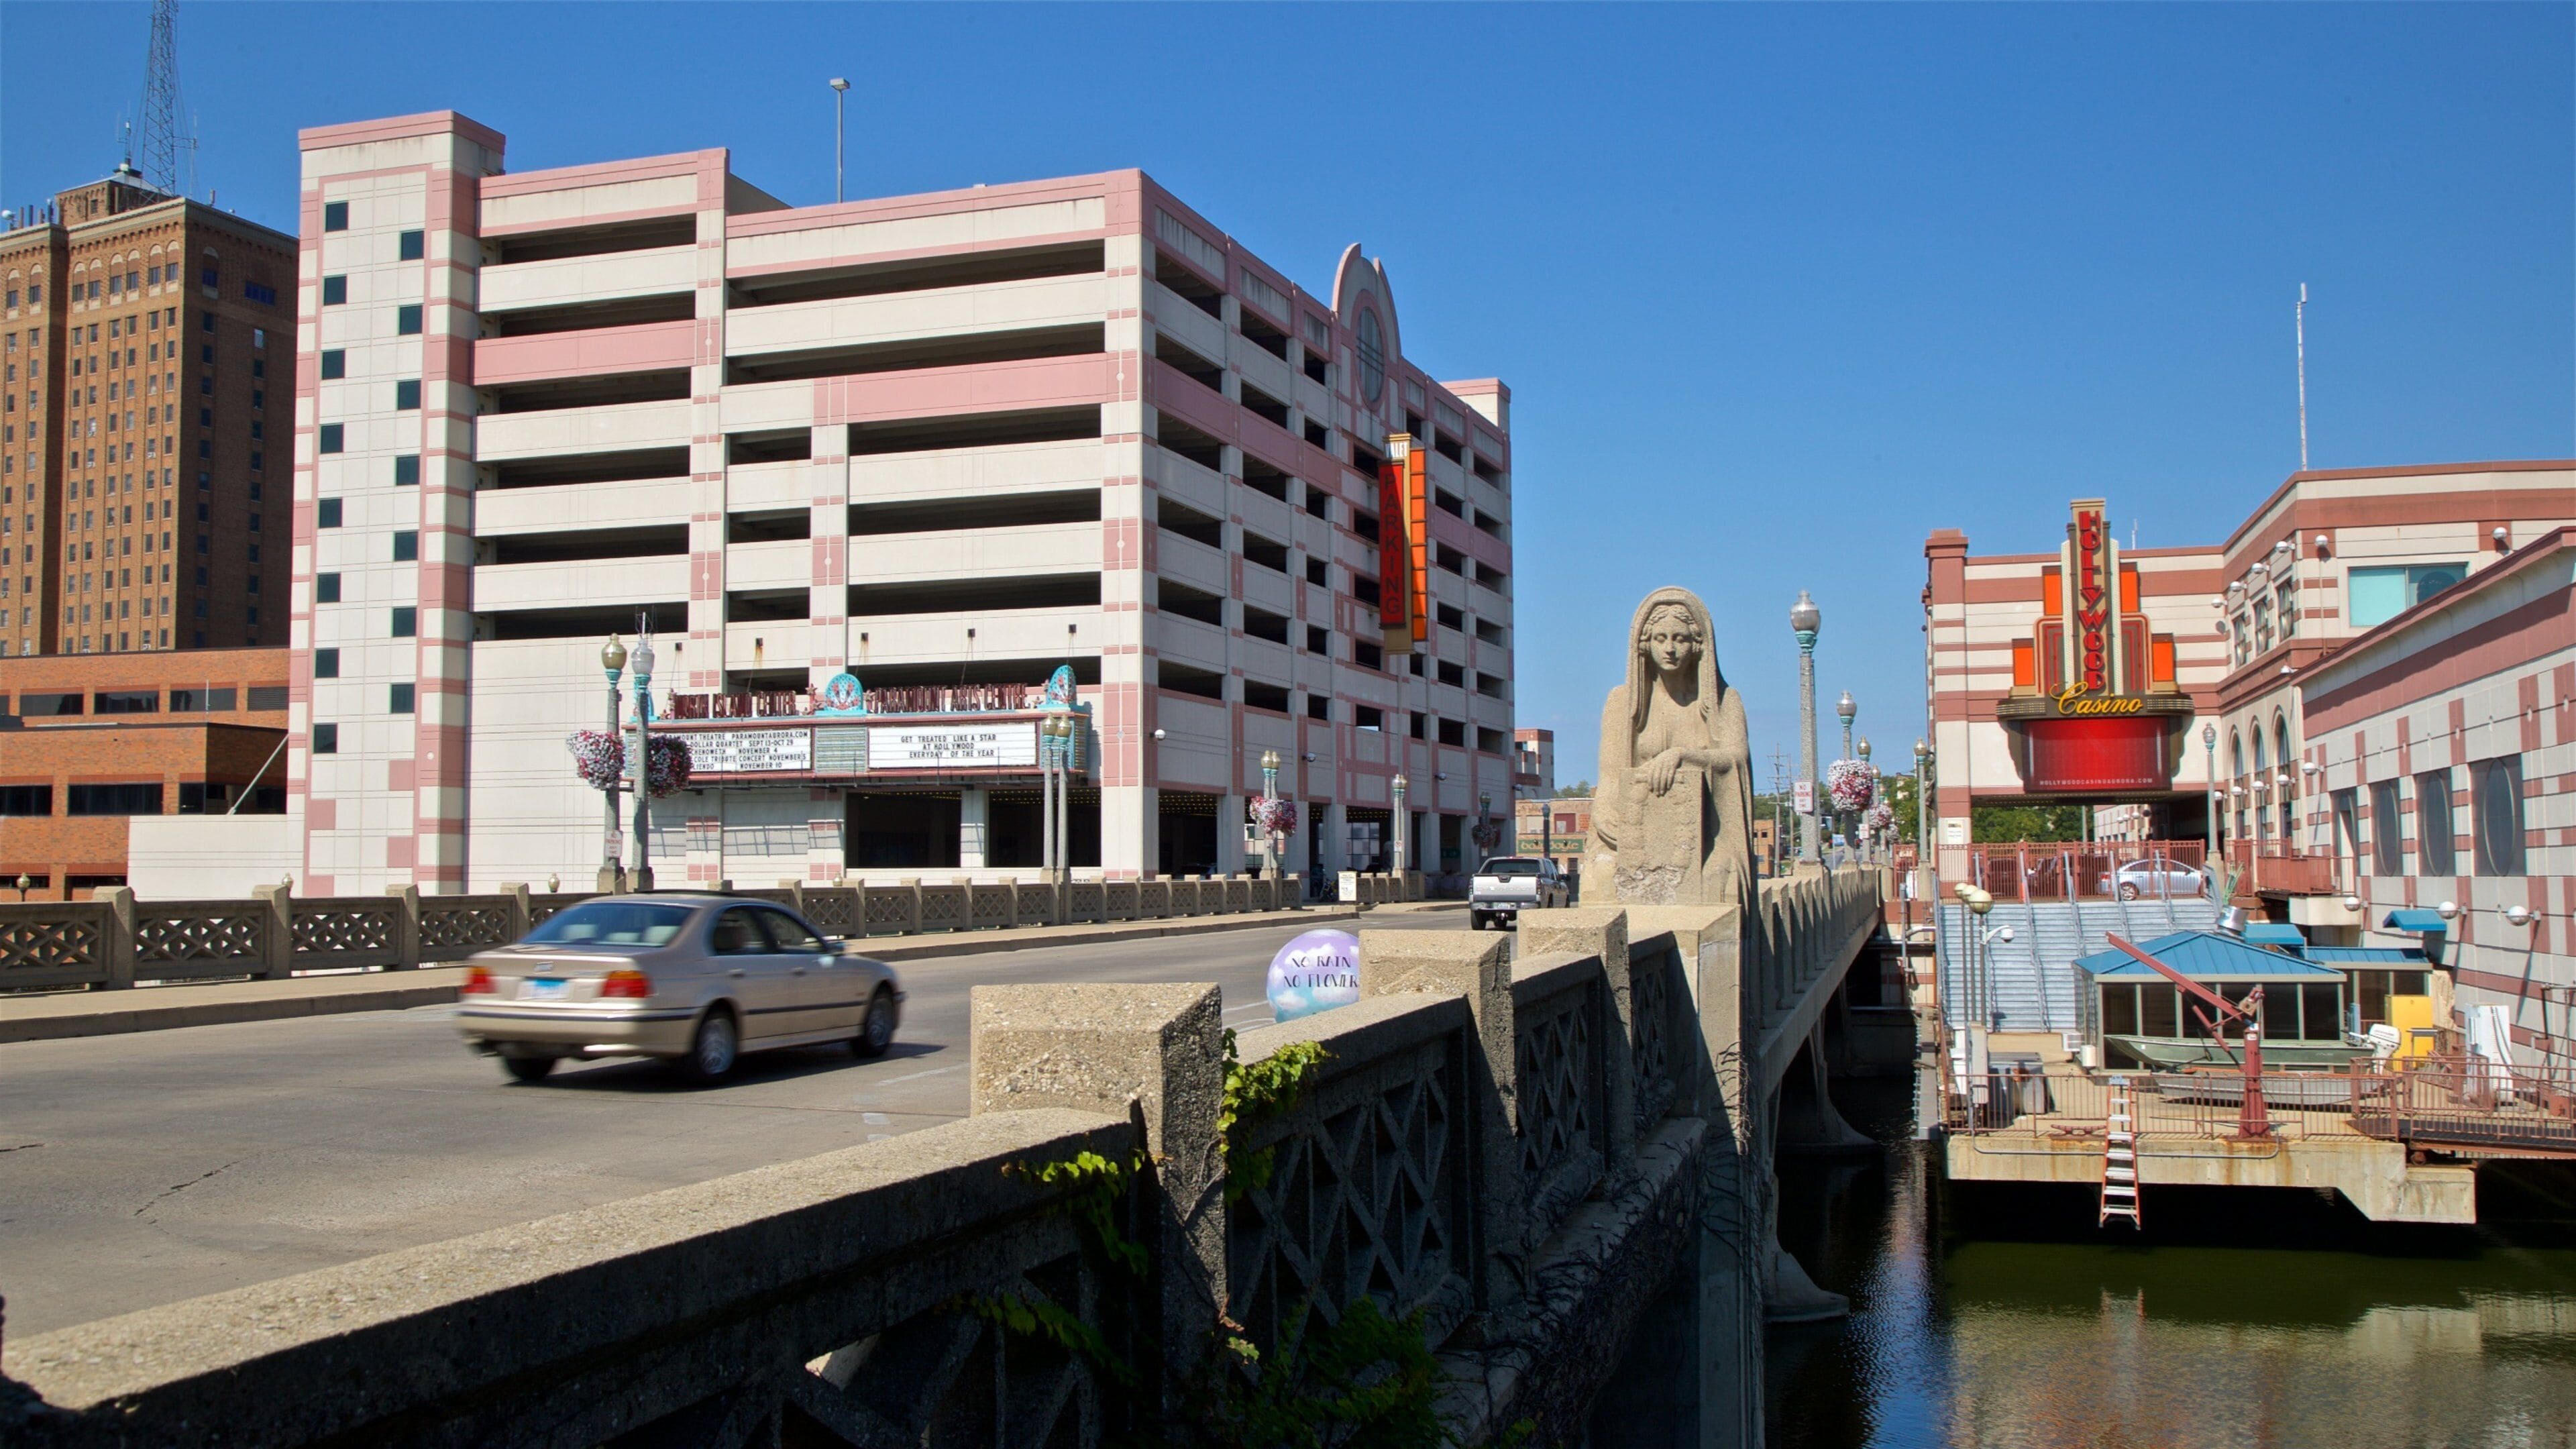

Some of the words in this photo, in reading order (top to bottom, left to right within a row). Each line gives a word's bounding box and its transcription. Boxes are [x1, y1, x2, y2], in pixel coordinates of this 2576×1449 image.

[1385, 473, 1400, 614] PARKING
[2078, 511, 2108, 691] HOLLYWOOD
[875, 686, 947, 713] PARAMOUNT
[951, 684, 980, 711] ARTS
[2049, 680, 2144, 716] Casino
[731, 731, 808, 739] PARAMOUNTAURORA.COM
[1291, 956, 1309, 967] NO
[1317, 956, 1351, 967] RAIN
[1283, 975, 1300, 987] NO
